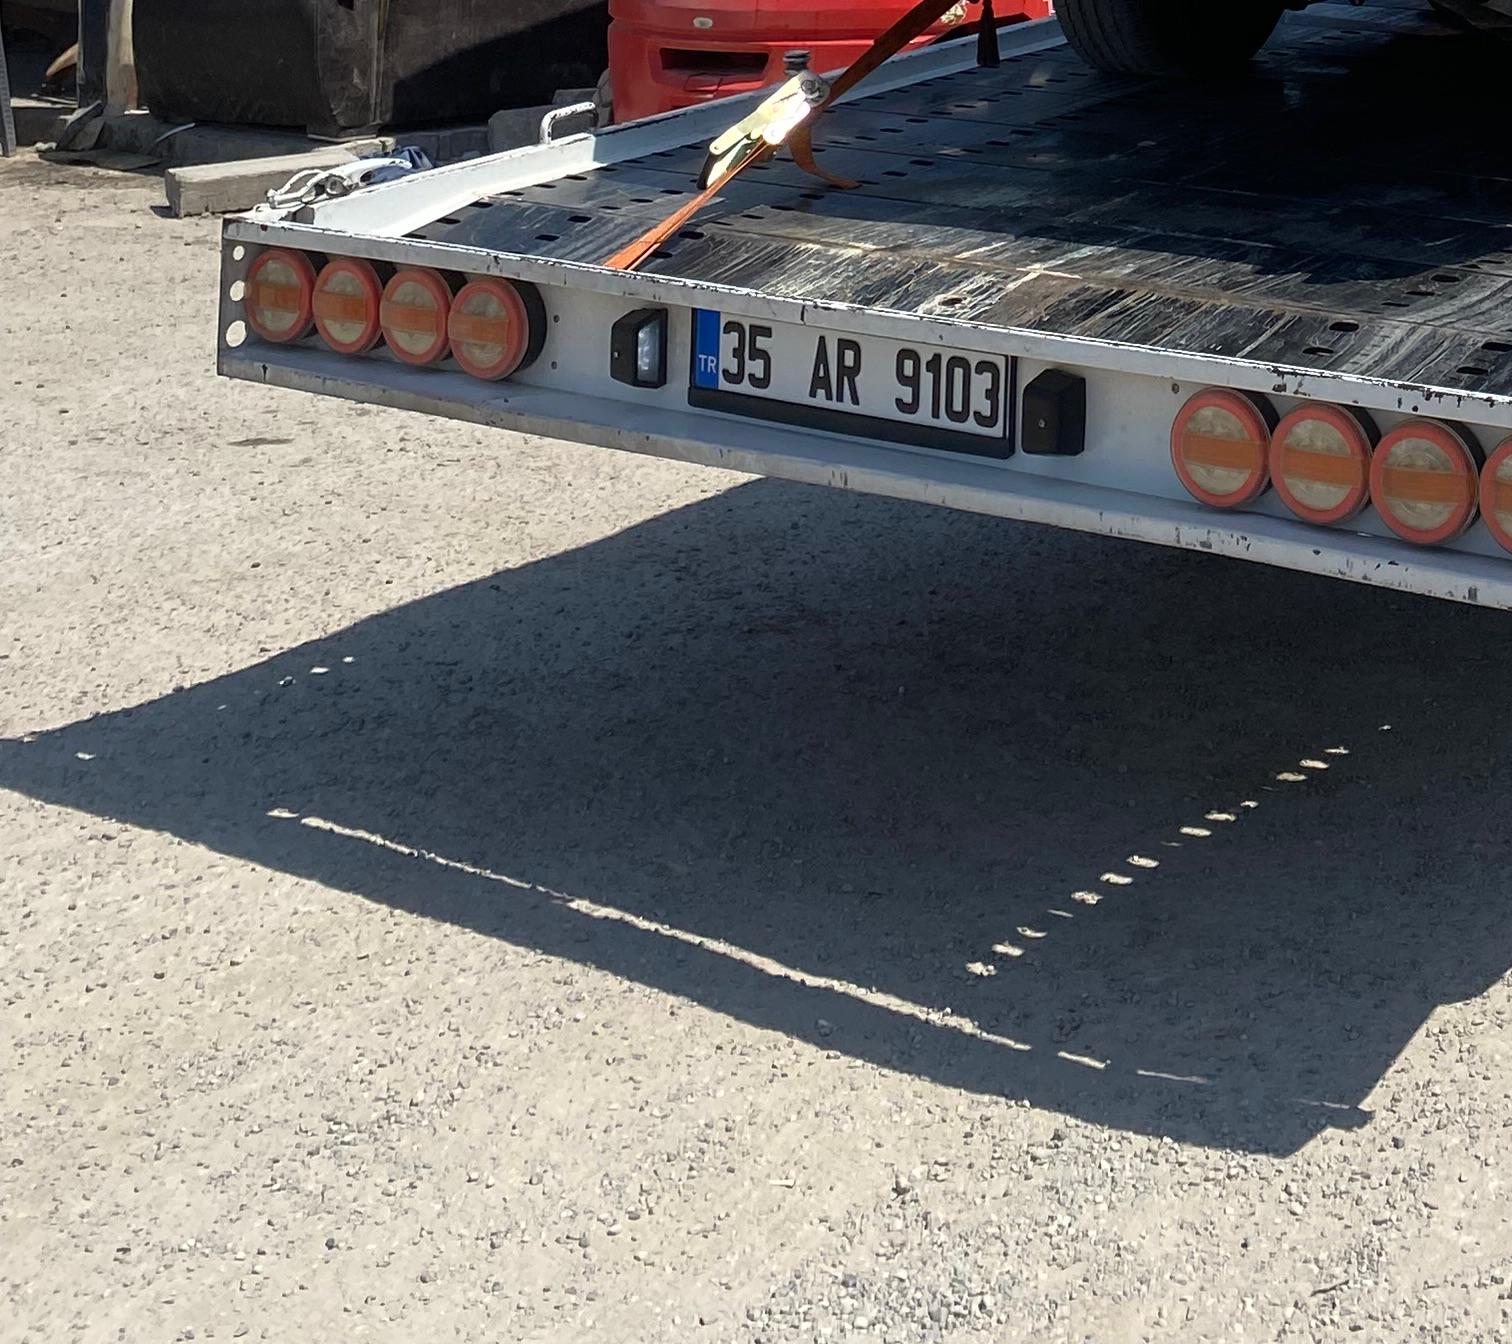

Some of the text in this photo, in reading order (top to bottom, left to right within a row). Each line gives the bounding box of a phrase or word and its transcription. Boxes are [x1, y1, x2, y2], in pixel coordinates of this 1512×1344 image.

[698, 320, 1000, 429] TR 35 AR 9103
